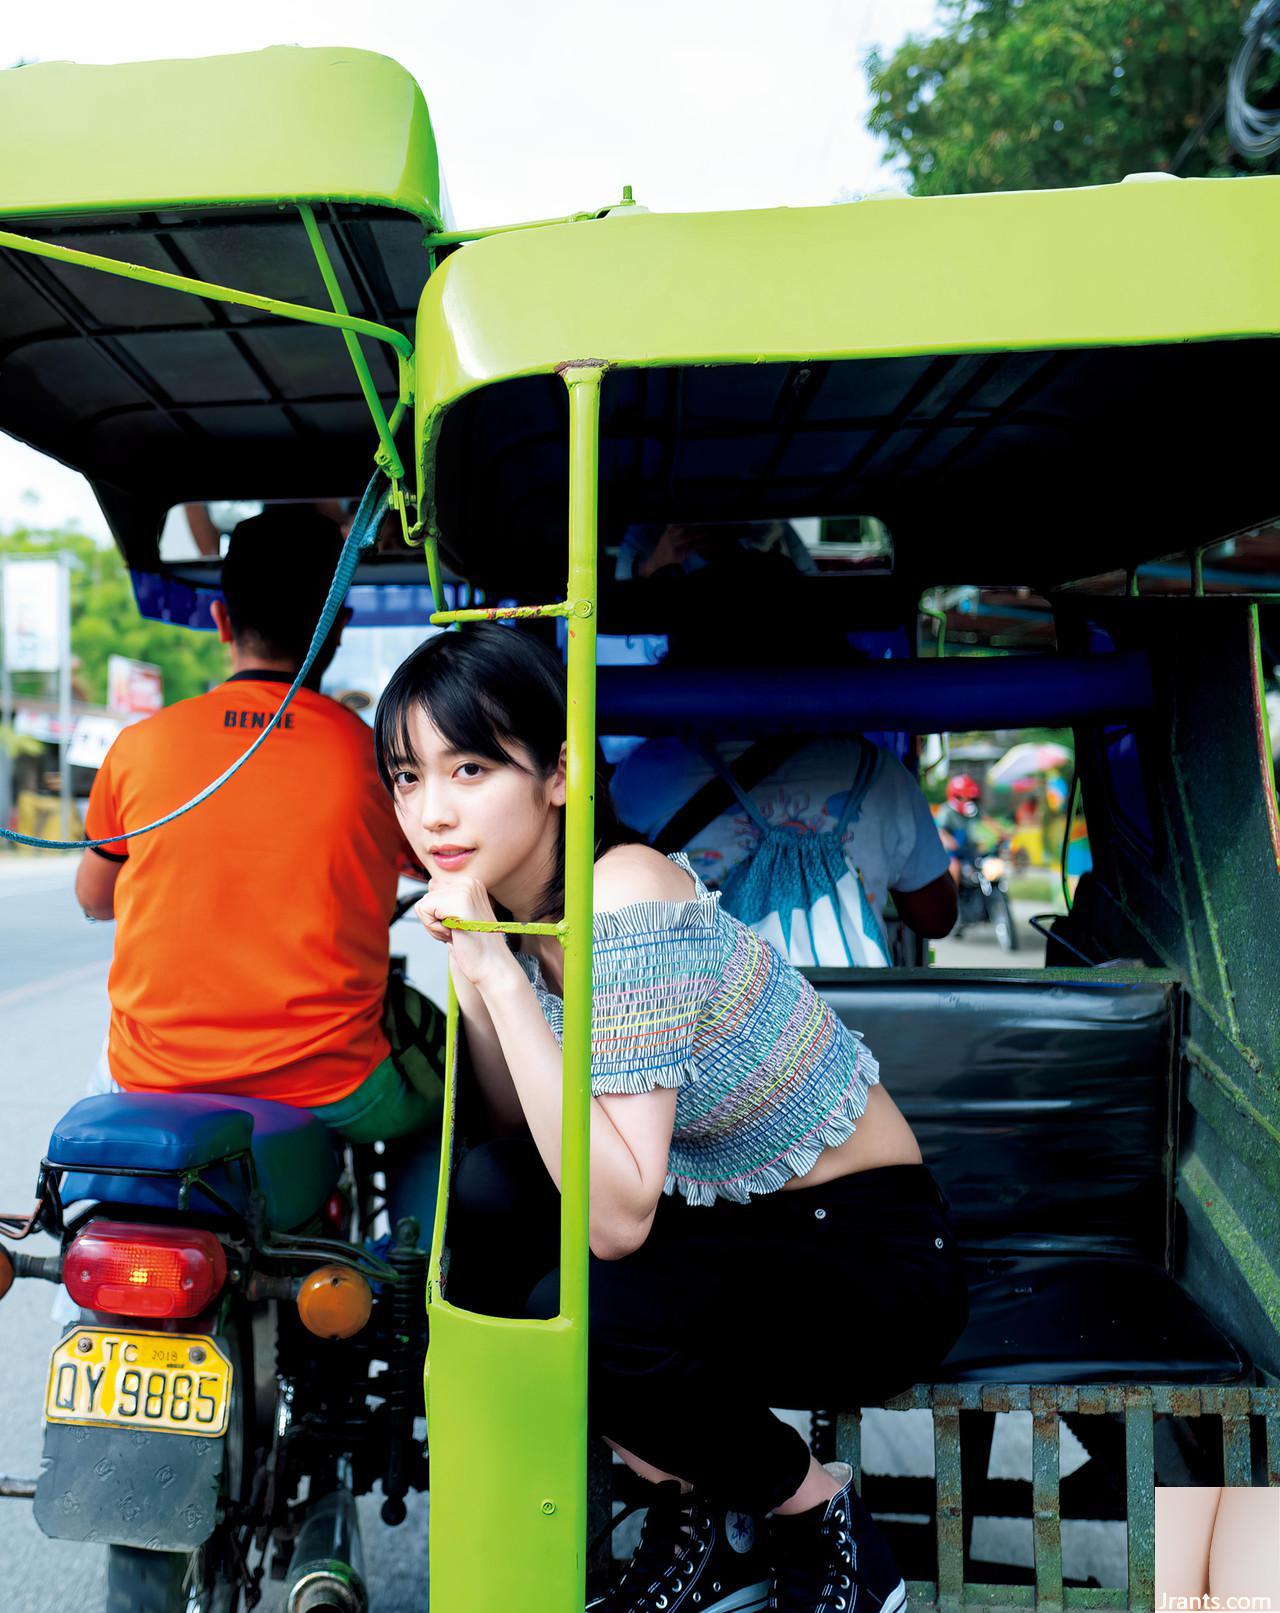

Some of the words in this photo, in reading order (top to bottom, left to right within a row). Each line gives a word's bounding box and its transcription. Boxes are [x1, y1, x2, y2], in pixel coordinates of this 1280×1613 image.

[151, 1350, 178, 1362] 2018
[56, 1362, 106, 1413] QY
[118, 1370, 218, 1423] 9885
